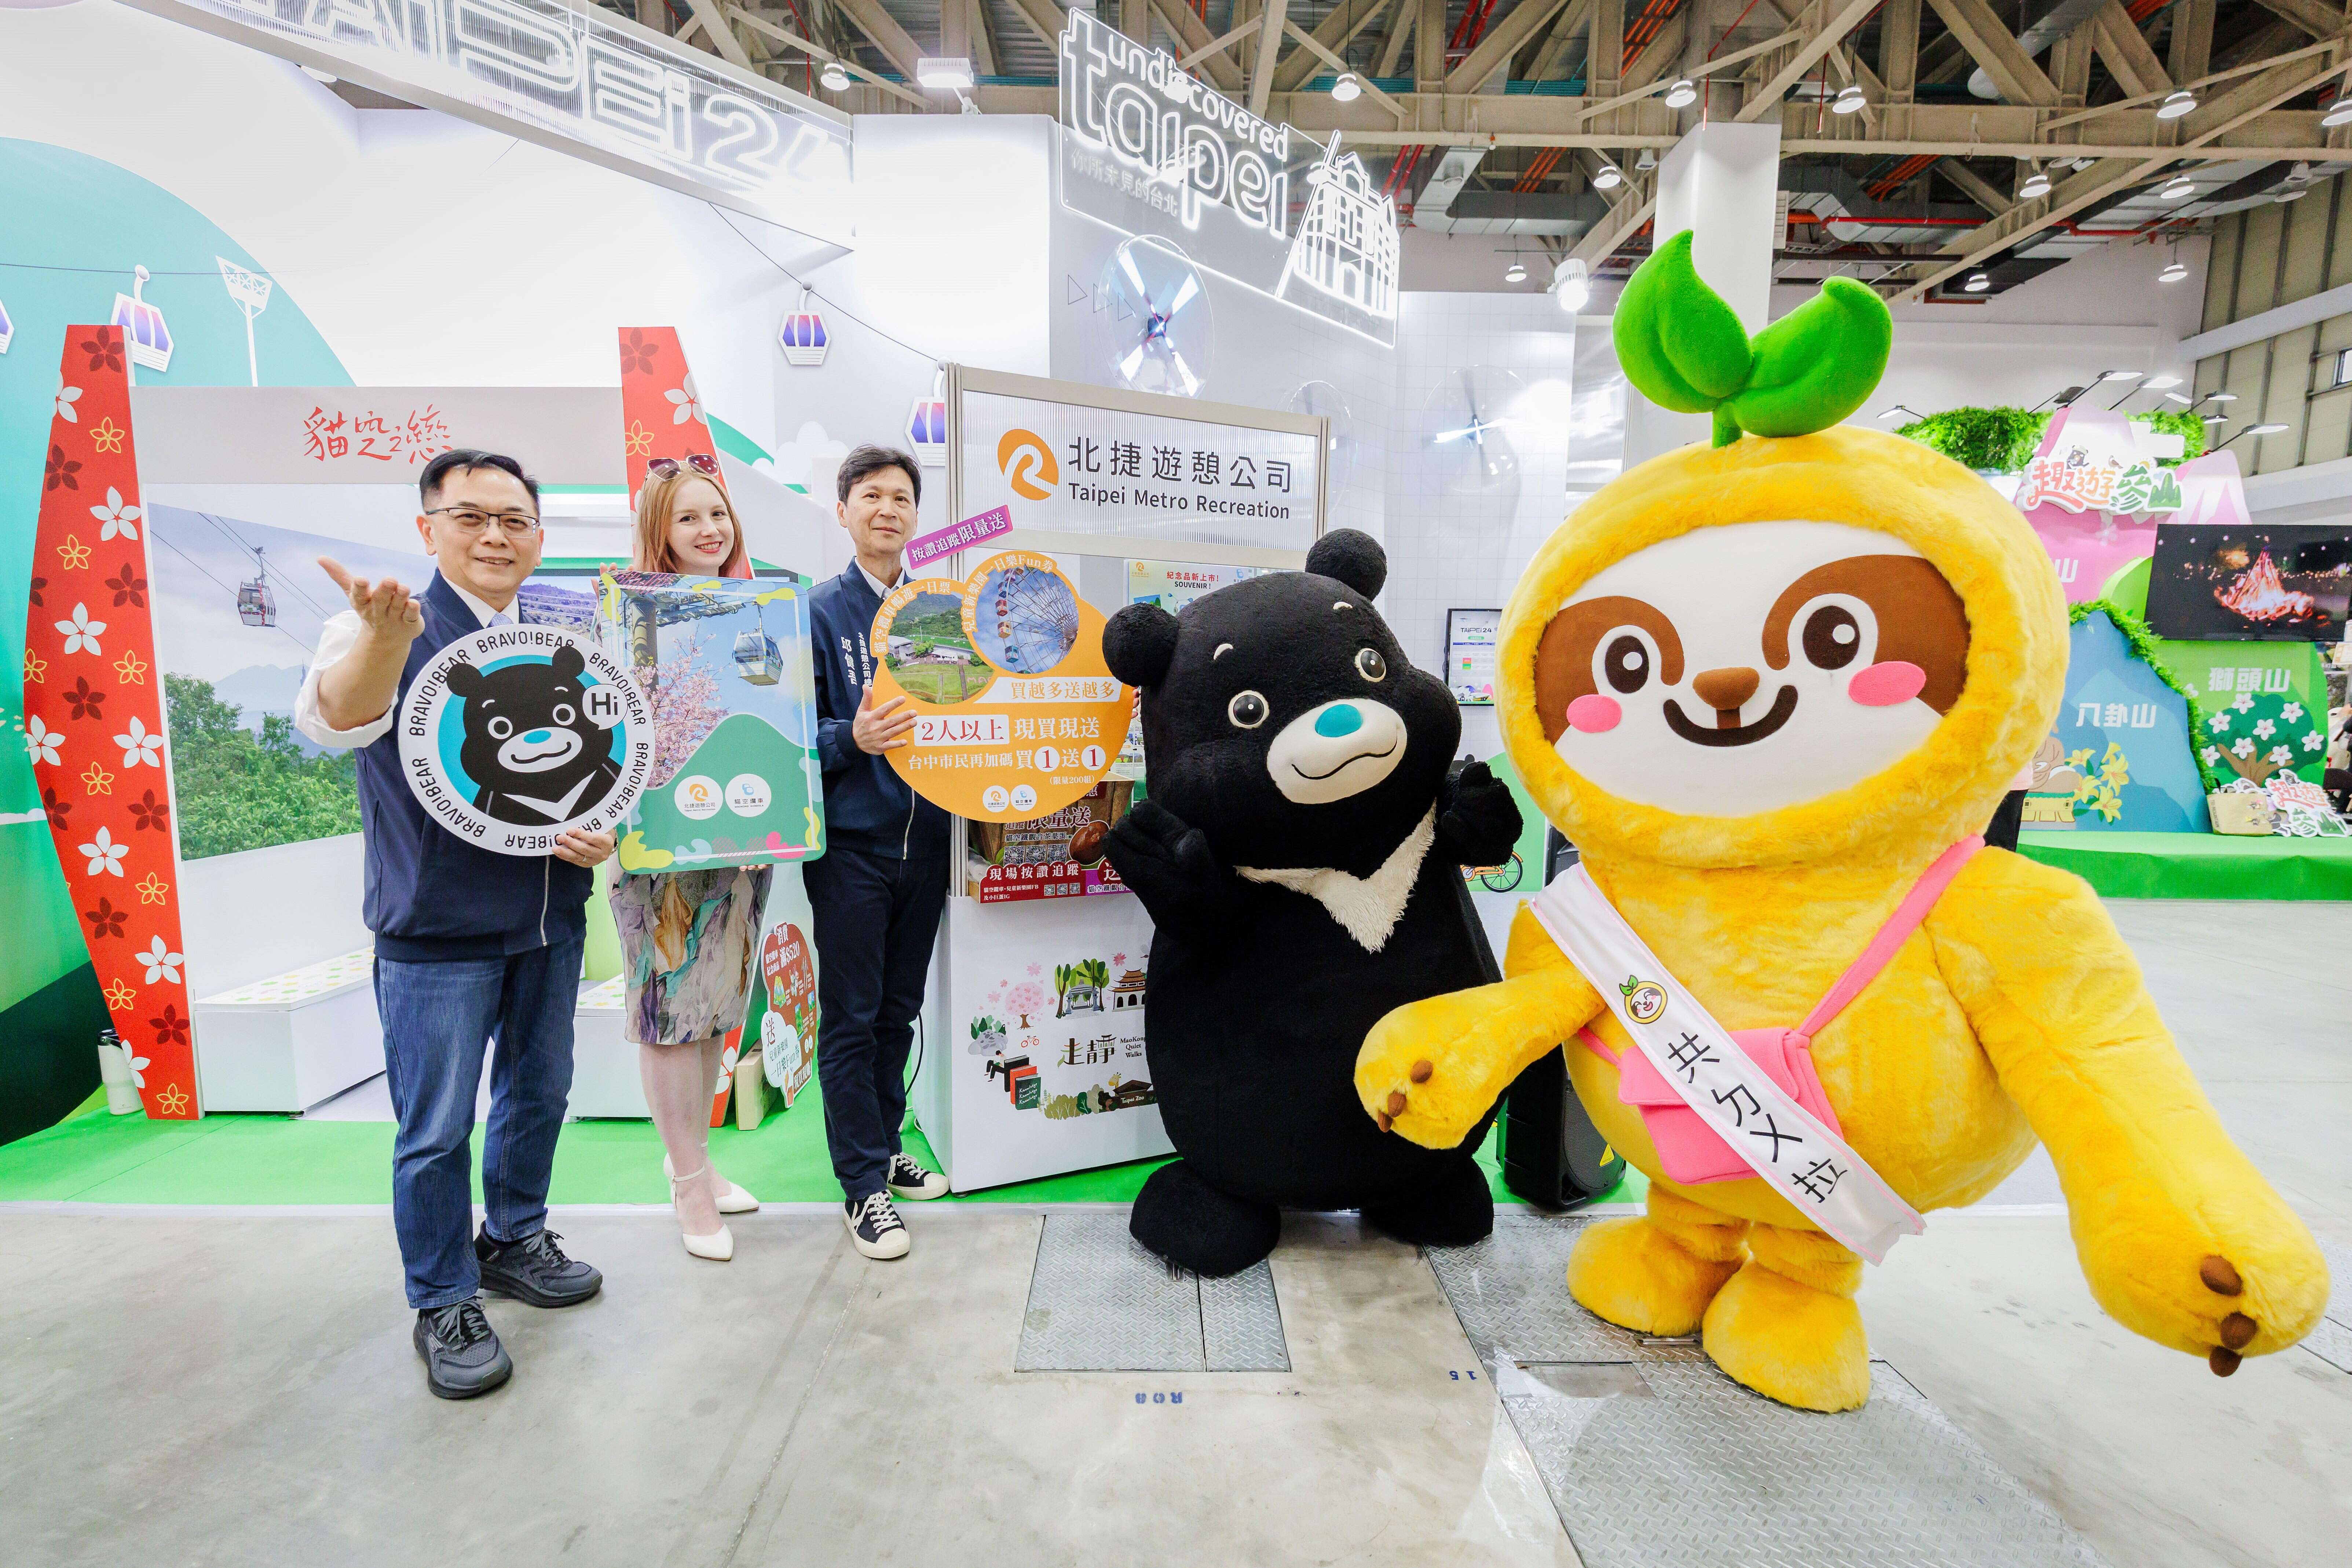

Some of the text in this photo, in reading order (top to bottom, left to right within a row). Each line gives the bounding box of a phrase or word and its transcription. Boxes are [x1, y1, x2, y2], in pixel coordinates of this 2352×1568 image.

[1108, 34, 1287, 162] undicovered
[1068, 436, 1291, 493] 北捷遊憩公司
[1068, 483, 1290, 519] Taipei Metro Recreation
[911, 512, 1006, 562] 按讚追蹤限量送
[1167, 571, 1219, 582] 紀念品新上市!
[2050, 557, 2079, 583] 山
[476, 631, 575, 653] BRAVO!BEAR
[409, 649, 471, 736] BRAVO!BEAR
[1011, 681, 1115, 700] 買越多送越多
[2208, 667, 2291, 692] 獅頭山
[591, 692, 618, 716] Hi
[2075, 702, 2157, 728] 八卦山
[921, 716, 1100, 742] 2人以上 現買現送
[606, 743, 649, 818] BRAVO!BEAR
[1050, 775, 1095, 785] (限量200組)
[413, 757, 486, 837] BRAVO!BEAR
[990, 863, 1079, 881] 現場按讚追蹤
[765, 1017, 776, 1048] 送
